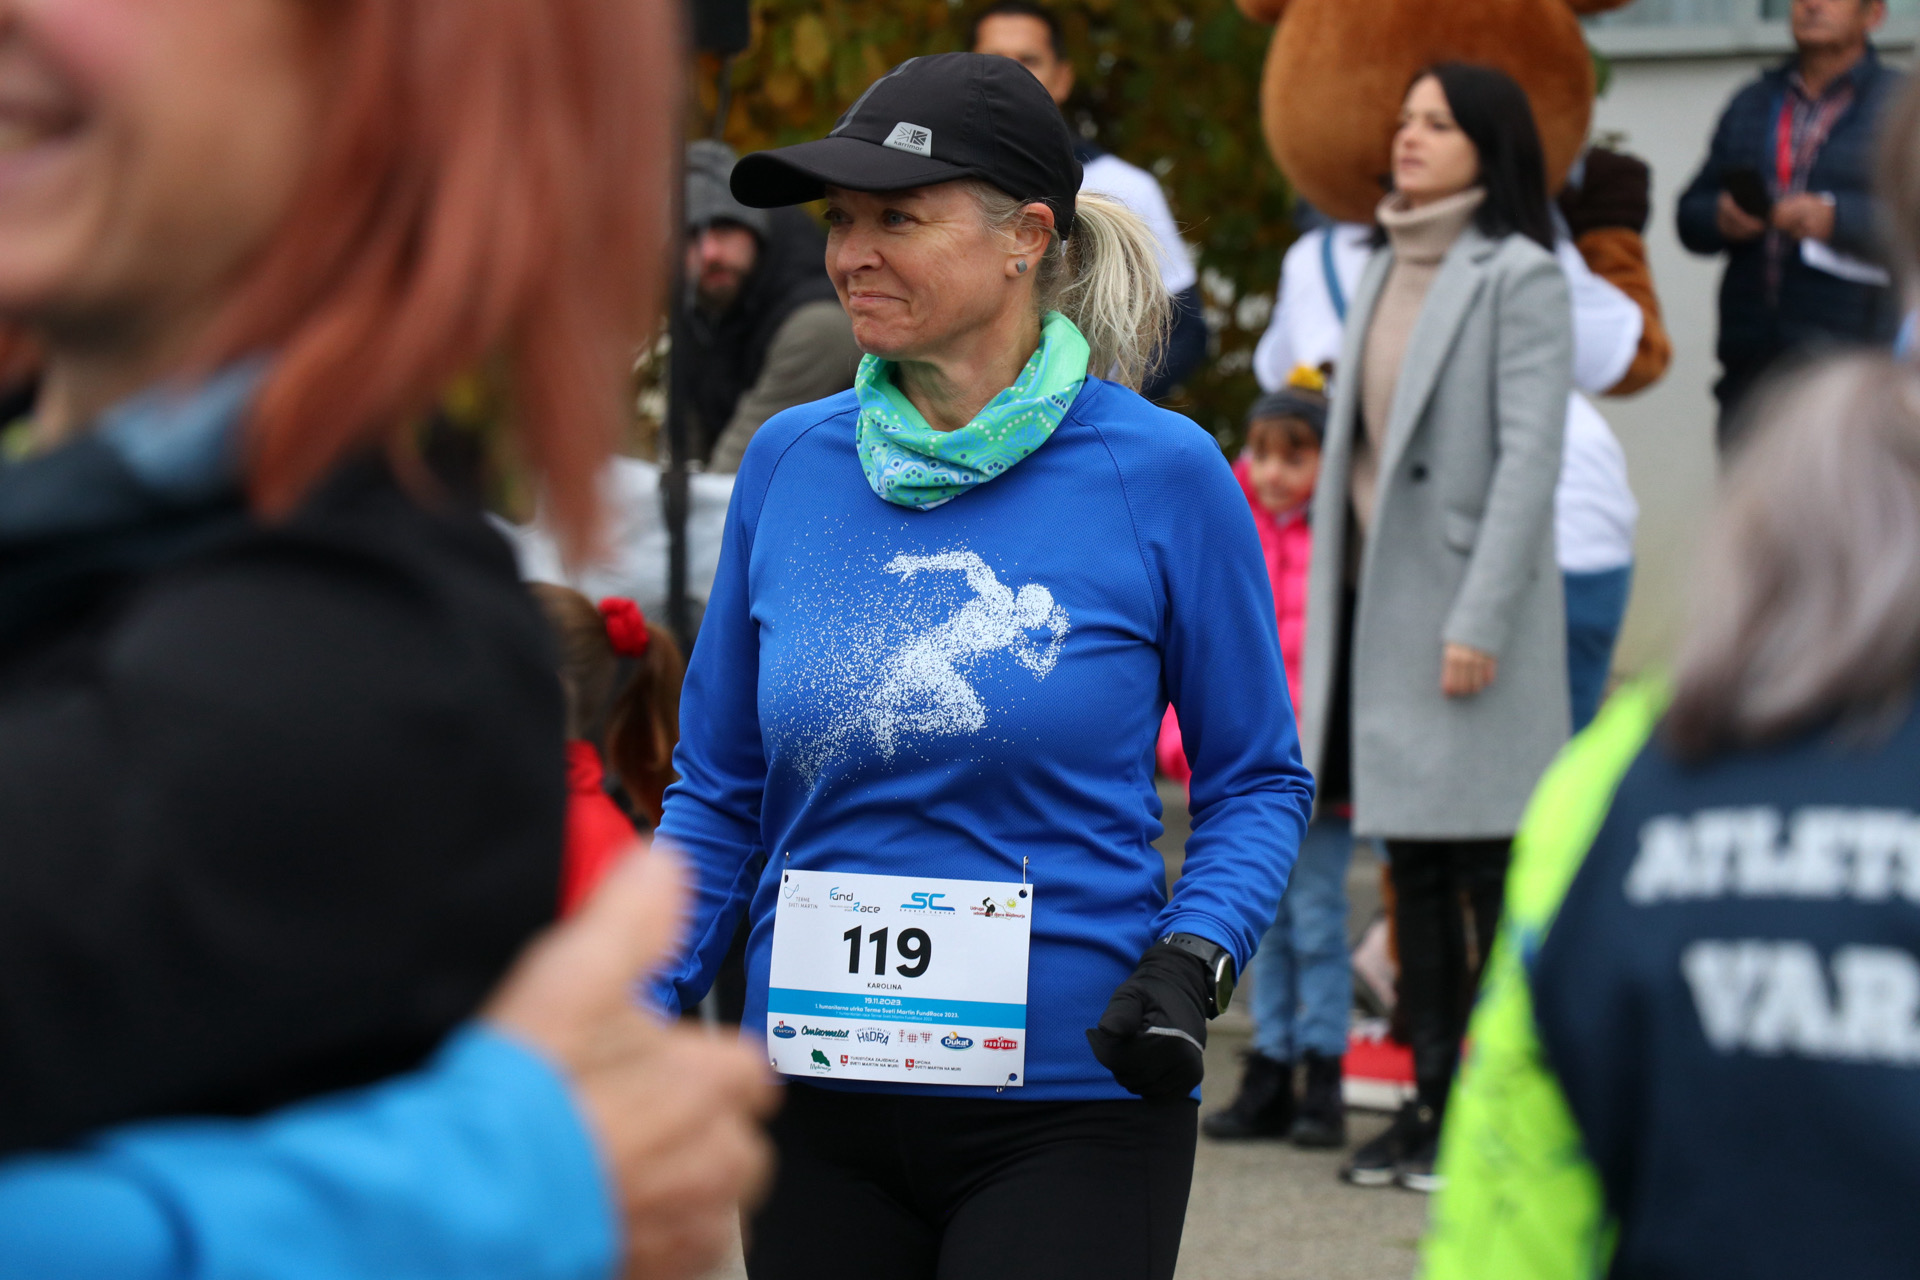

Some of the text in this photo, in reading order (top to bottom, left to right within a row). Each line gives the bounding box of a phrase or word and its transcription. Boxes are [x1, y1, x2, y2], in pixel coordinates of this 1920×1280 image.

[893, 140, 924, 151] karrimor
[829, 886, 854, 902] Fund
[852, 901, 881, 914] Race
[900, 892, 956, 911] SC
[843, 925, 932, 979] 119
[867, 982, 902, 990] KAROLINA
[864, 997, 902, 1006] 19.11.2023.
[945, 1038, 969, 1046] Dukat
